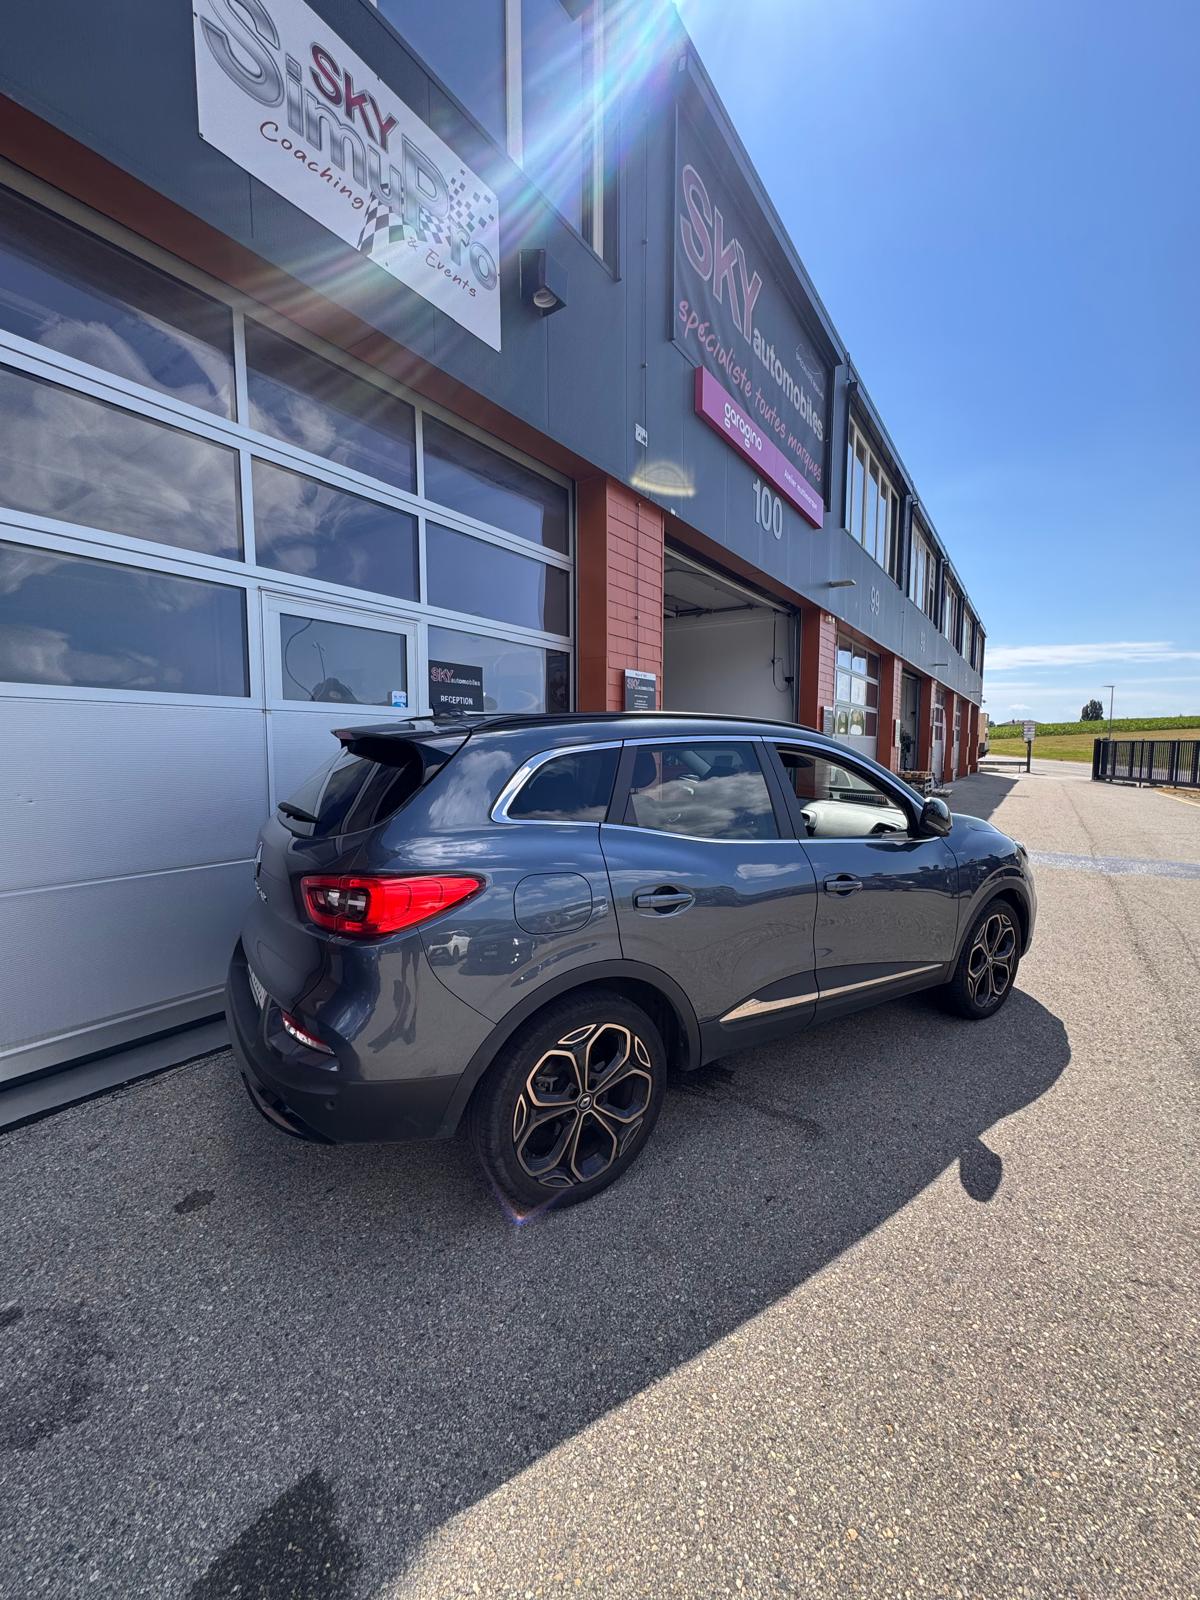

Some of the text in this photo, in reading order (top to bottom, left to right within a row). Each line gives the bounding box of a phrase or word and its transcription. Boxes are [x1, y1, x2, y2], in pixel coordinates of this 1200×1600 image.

[310, 41, 398, 154] SKY
[259, 120, 364, 210] Coaching
[424, 249, 477, 298] Events
[680, 164, 762, 345] SKY
[679, 300, 752, 398] spécialiste
[755, 387, 786, 438] toutes
[787, 432, 822, 482] marques
[752, 327, 823, 442] automobiles
[752, 478, 783, 540] 100
[870, 586, 880, 616] 99
[430, 666, 454, 683] SKY
[440, 695, 473, 705] RECEPTION
